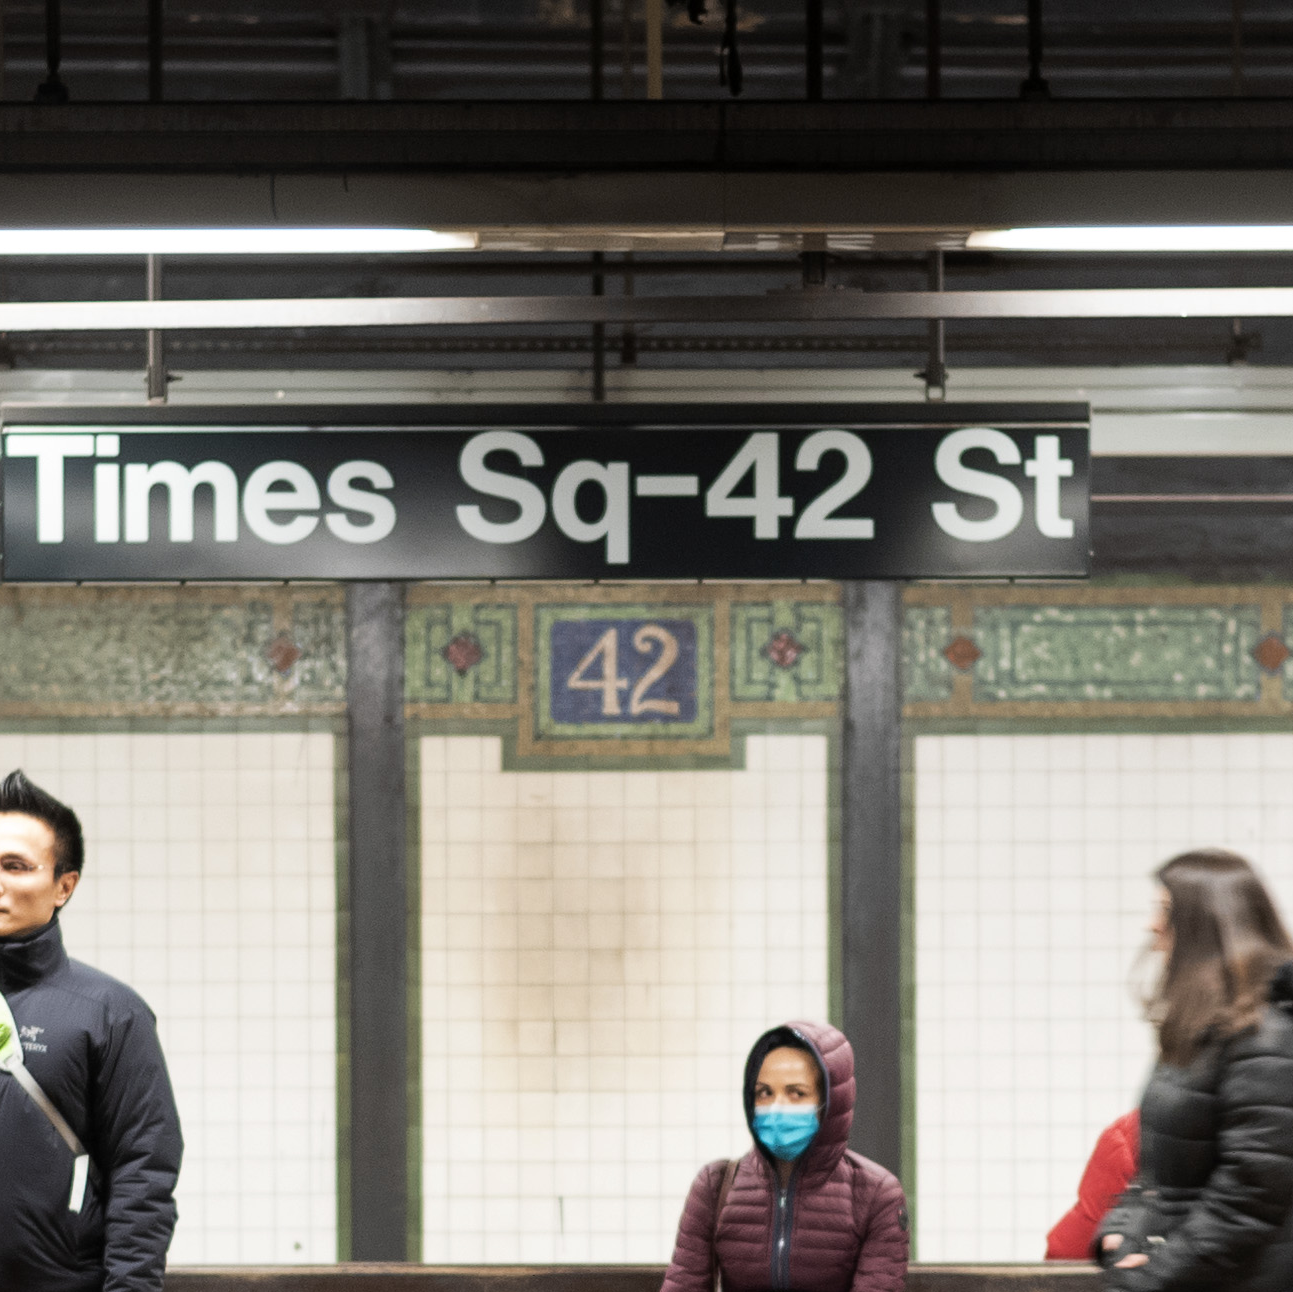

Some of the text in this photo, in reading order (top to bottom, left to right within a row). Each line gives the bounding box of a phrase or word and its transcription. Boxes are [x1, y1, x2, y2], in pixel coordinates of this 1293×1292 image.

[5, 427, 1075, 564] Times Sq-42 St
[567, 624, 680, 717] 42
